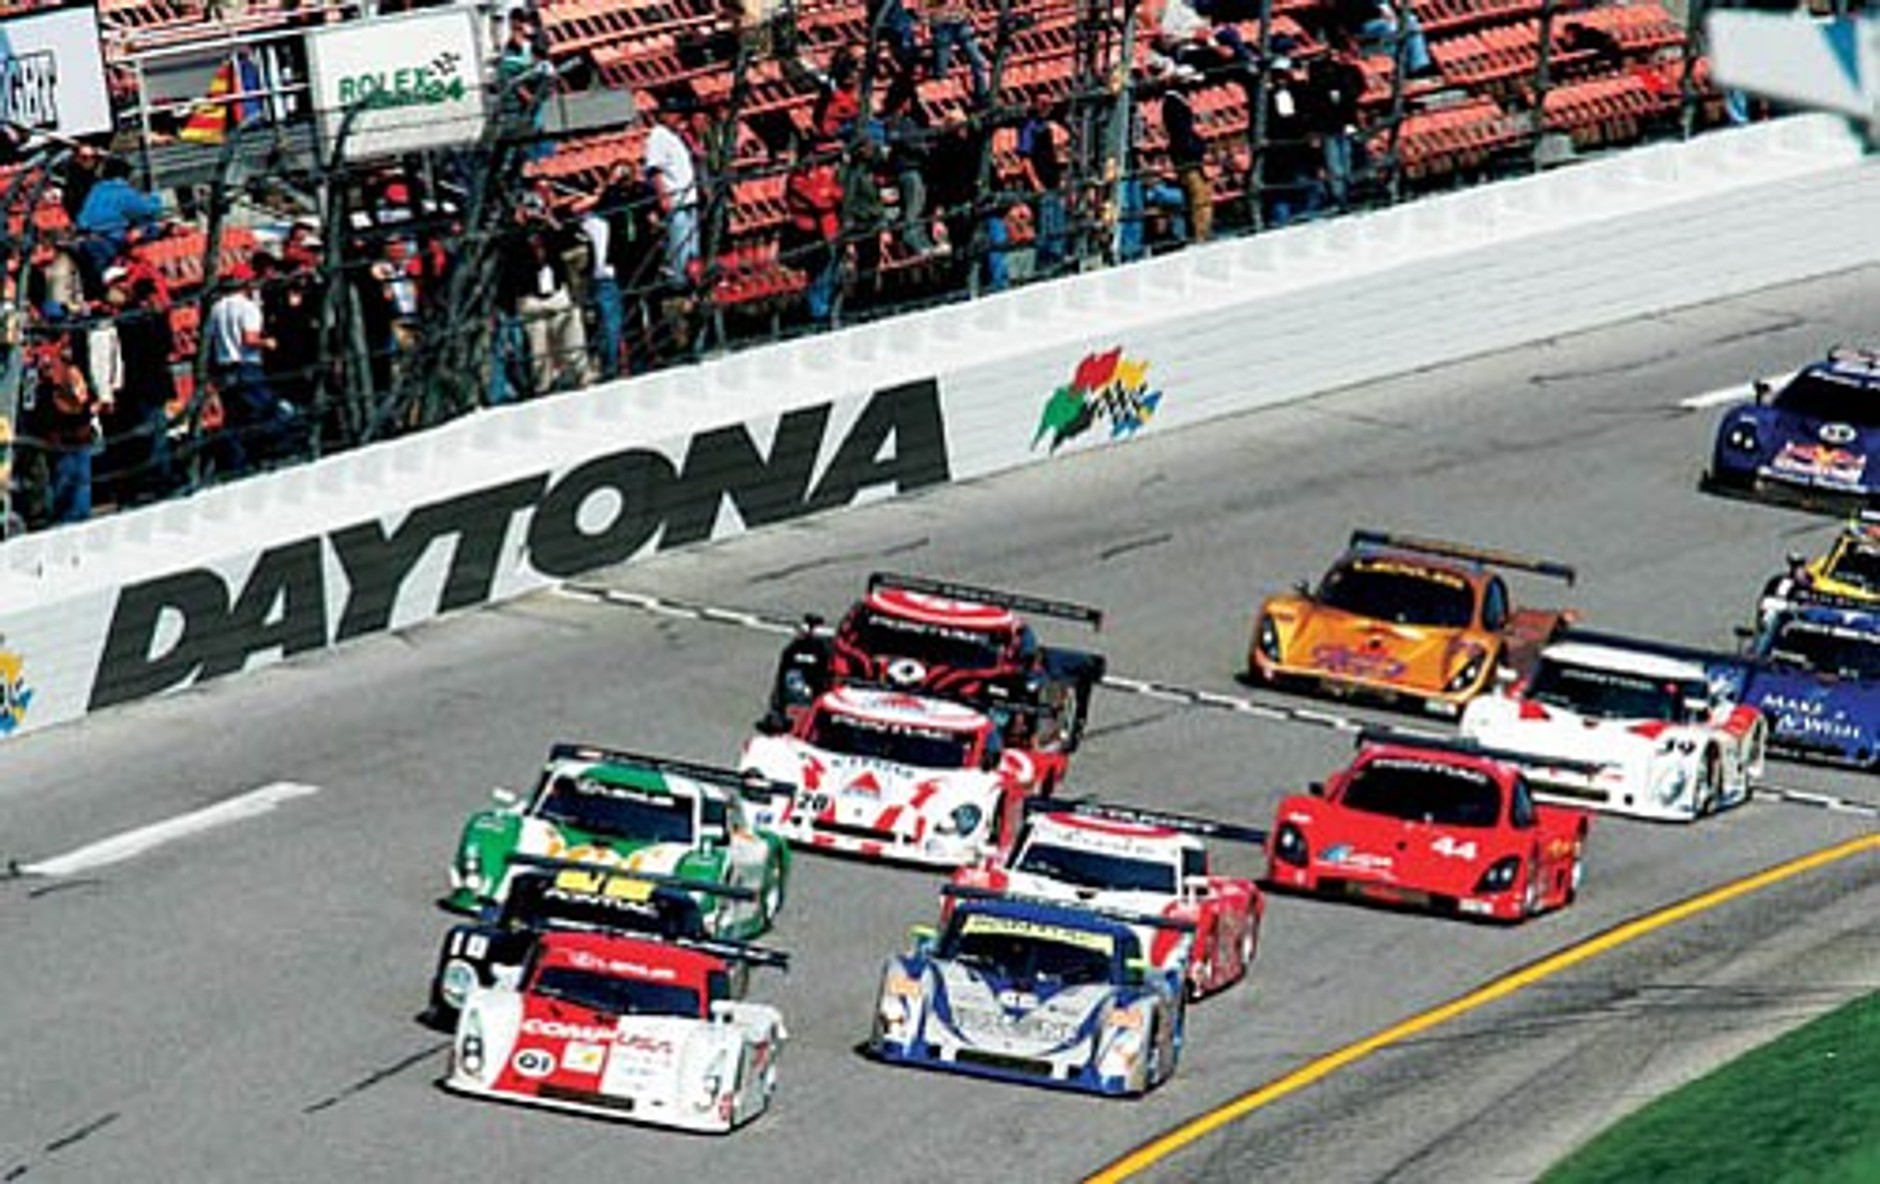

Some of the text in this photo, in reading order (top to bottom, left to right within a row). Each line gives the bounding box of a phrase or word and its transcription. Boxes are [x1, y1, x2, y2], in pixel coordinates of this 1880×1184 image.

[338, 67, 427, 102] ROLEX
[87, 378, 951, 712] DAYTONA
[1430, 837, 1477, 861] 44
